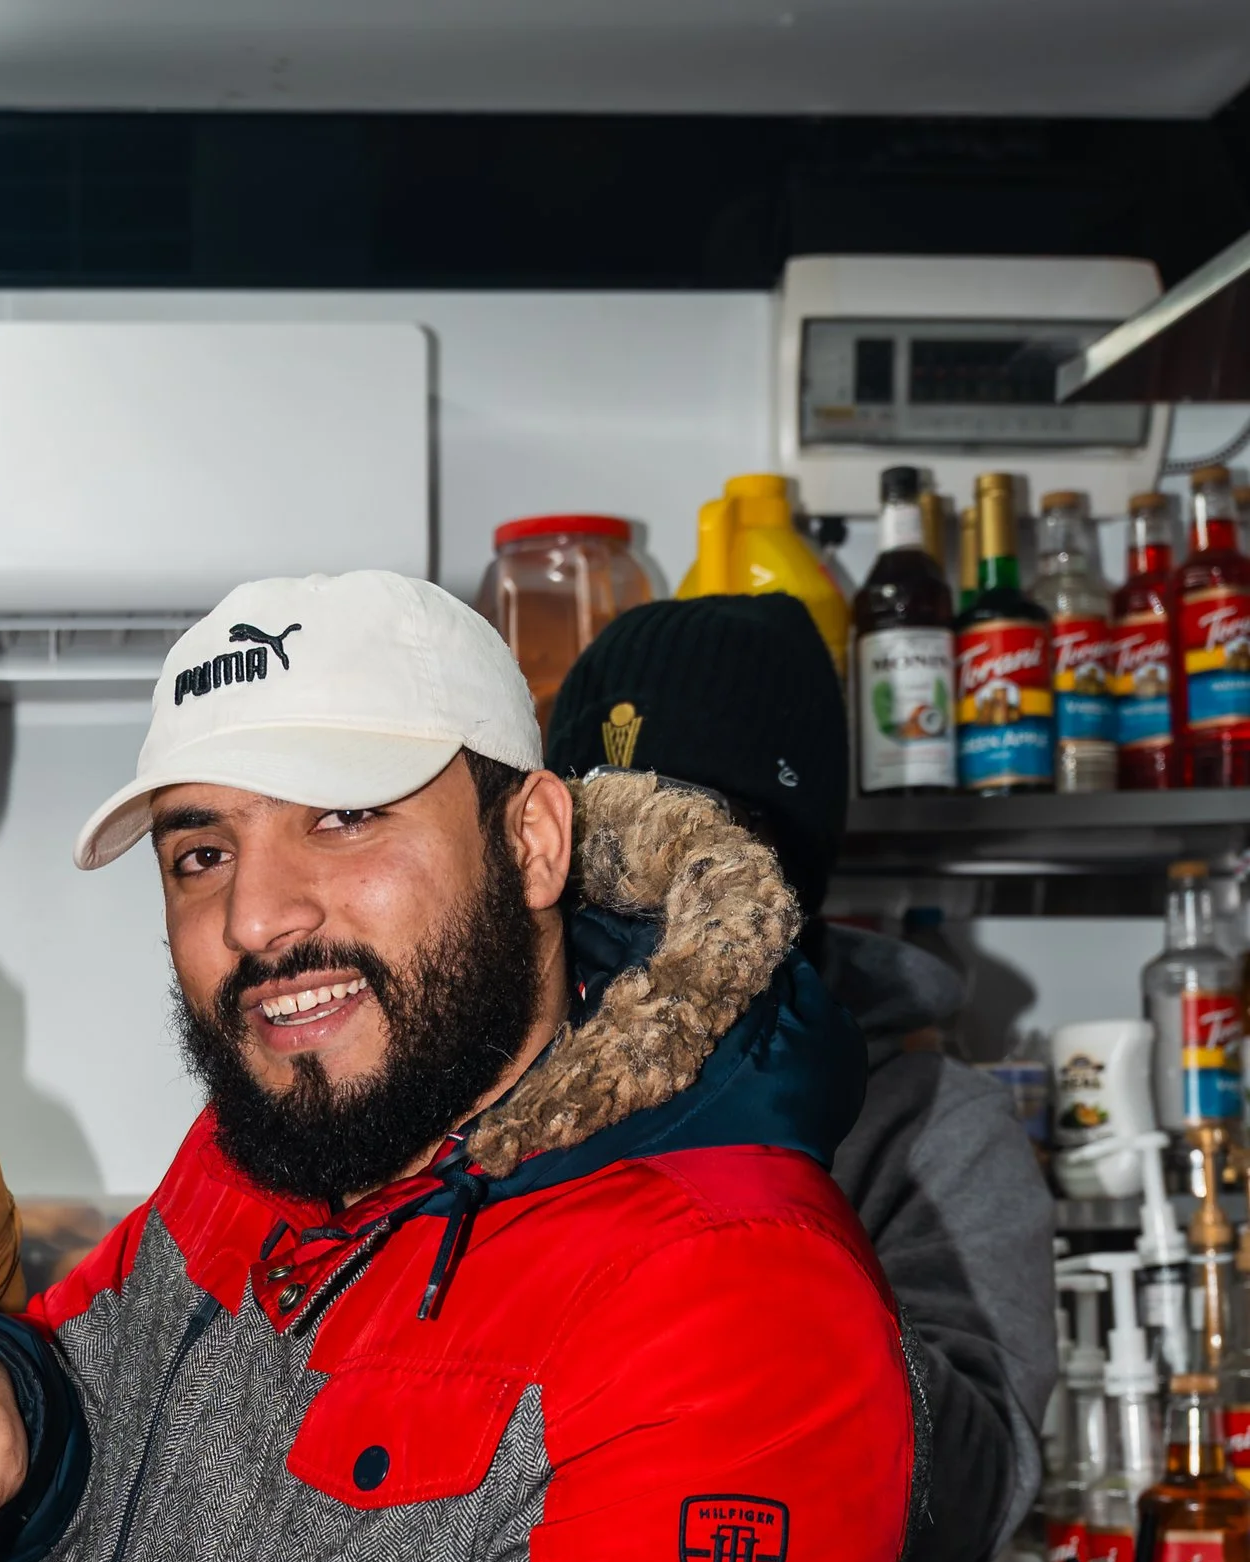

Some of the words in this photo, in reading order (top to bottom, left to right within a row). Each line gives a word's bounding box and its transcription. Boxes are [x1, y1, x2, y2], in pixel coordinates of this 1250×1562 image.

[174, 646, 268, 706] PUMA
[957, 636, 1044, 698] Torani
[699, 1508, 775, 1525] HILFIGER
